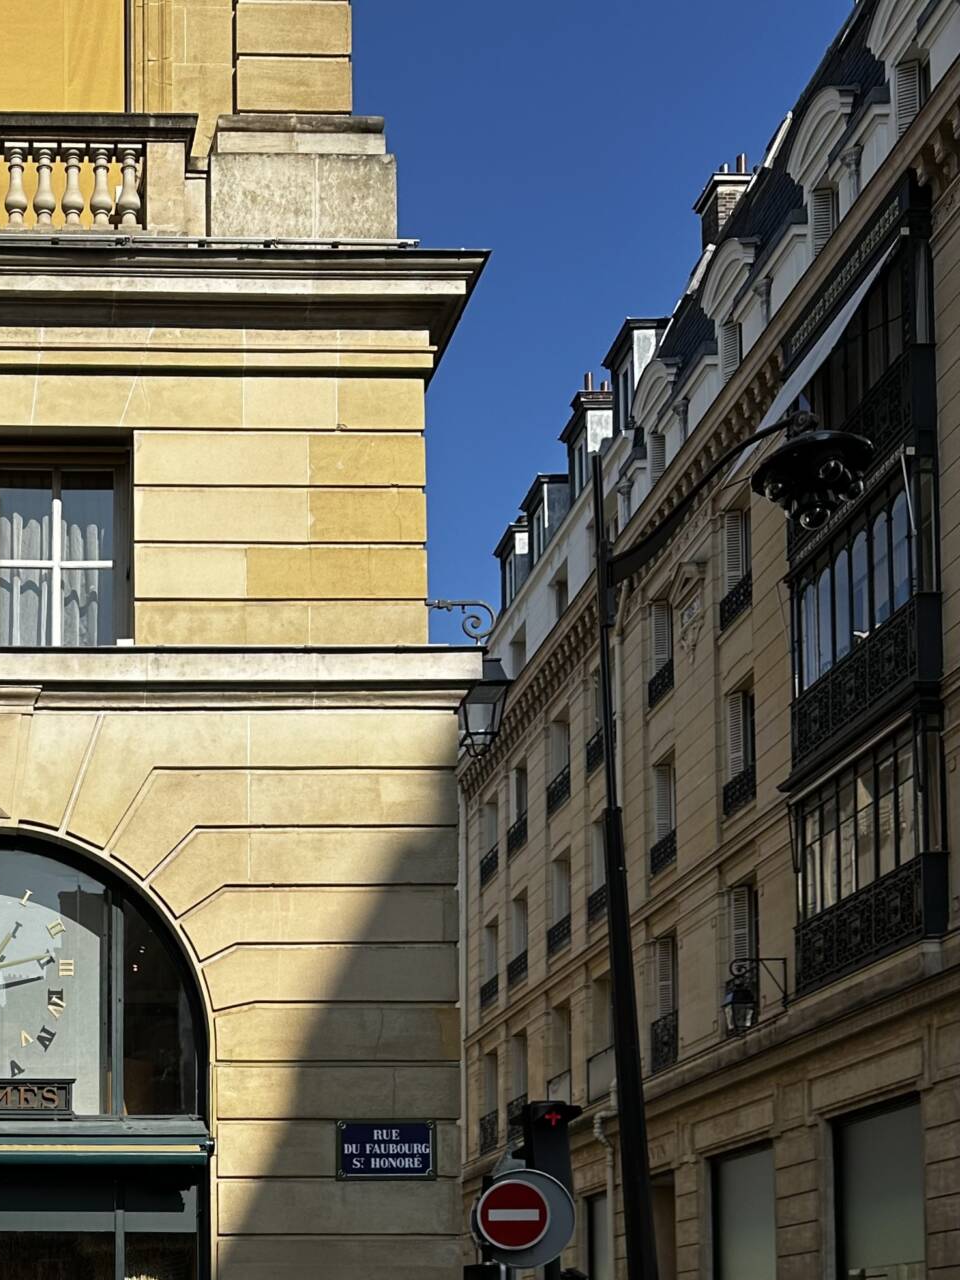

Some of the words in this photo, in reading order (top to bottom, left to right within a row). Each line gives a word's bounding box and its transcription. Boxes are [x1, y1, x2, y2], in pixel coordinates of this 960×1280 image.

[373, 1129, 400, 1140] RUE
[344, 1144, 360, 1154] DU
[365, 1143, 430, 1154] FAUBOURG
[370, 1155, 423, 1168] HONORÉ
